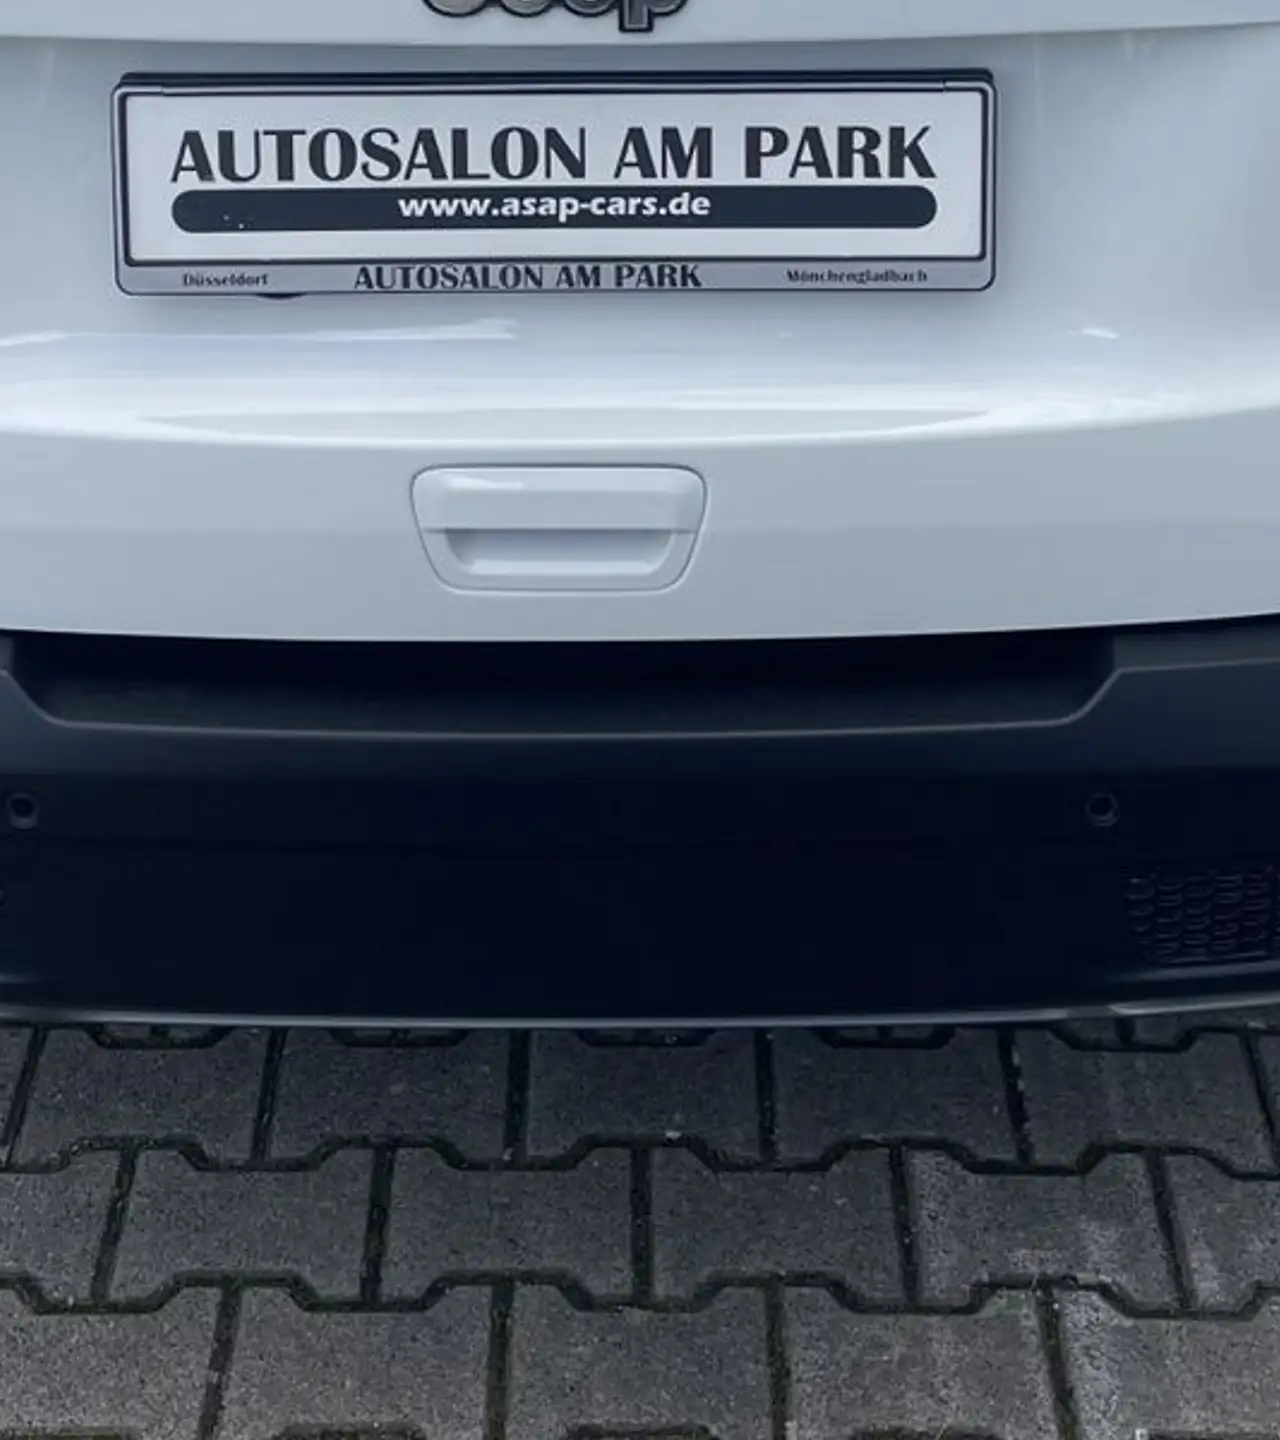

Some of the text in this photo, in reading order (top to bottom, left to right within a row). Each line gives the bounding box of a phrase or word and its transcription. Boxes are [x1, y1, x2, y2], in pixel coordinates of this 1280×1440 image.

[171, 126, 937, 182] AUTOSALON AM PARK
[398, 192, 712, 223] www.asap-cars.de
[182, 271, 269, 288] Düsseldorf
[353, 263, 703, 290] AUTOSALON AM PARK
[786, 267, 928, 285] Mönchengladbach
